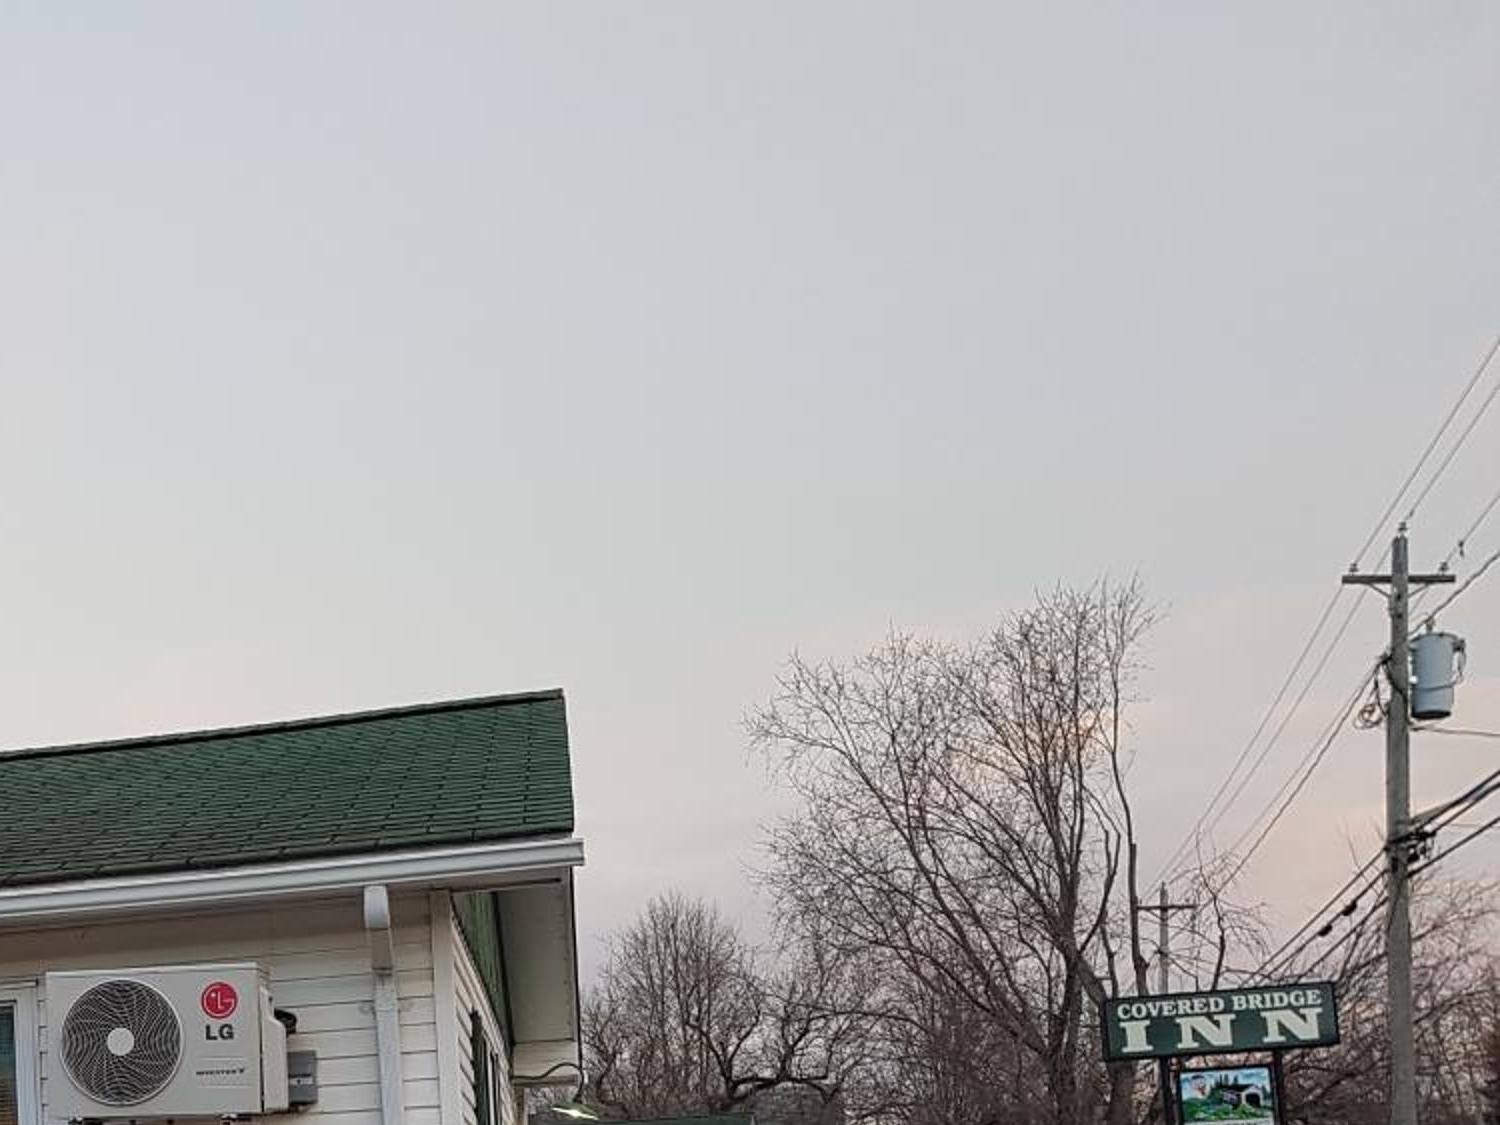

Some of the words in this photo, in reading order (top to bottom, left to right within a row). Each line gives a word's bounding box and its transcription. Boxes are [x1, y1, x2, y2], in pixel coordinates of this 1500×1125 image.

[1117, 997, 1224, 1019] COVERED
[1233, 989, 1322, 1010] BRIDGE
[205, 1023, 234, 1041] LG
[1120, 1007, 1322, 1053] INN
